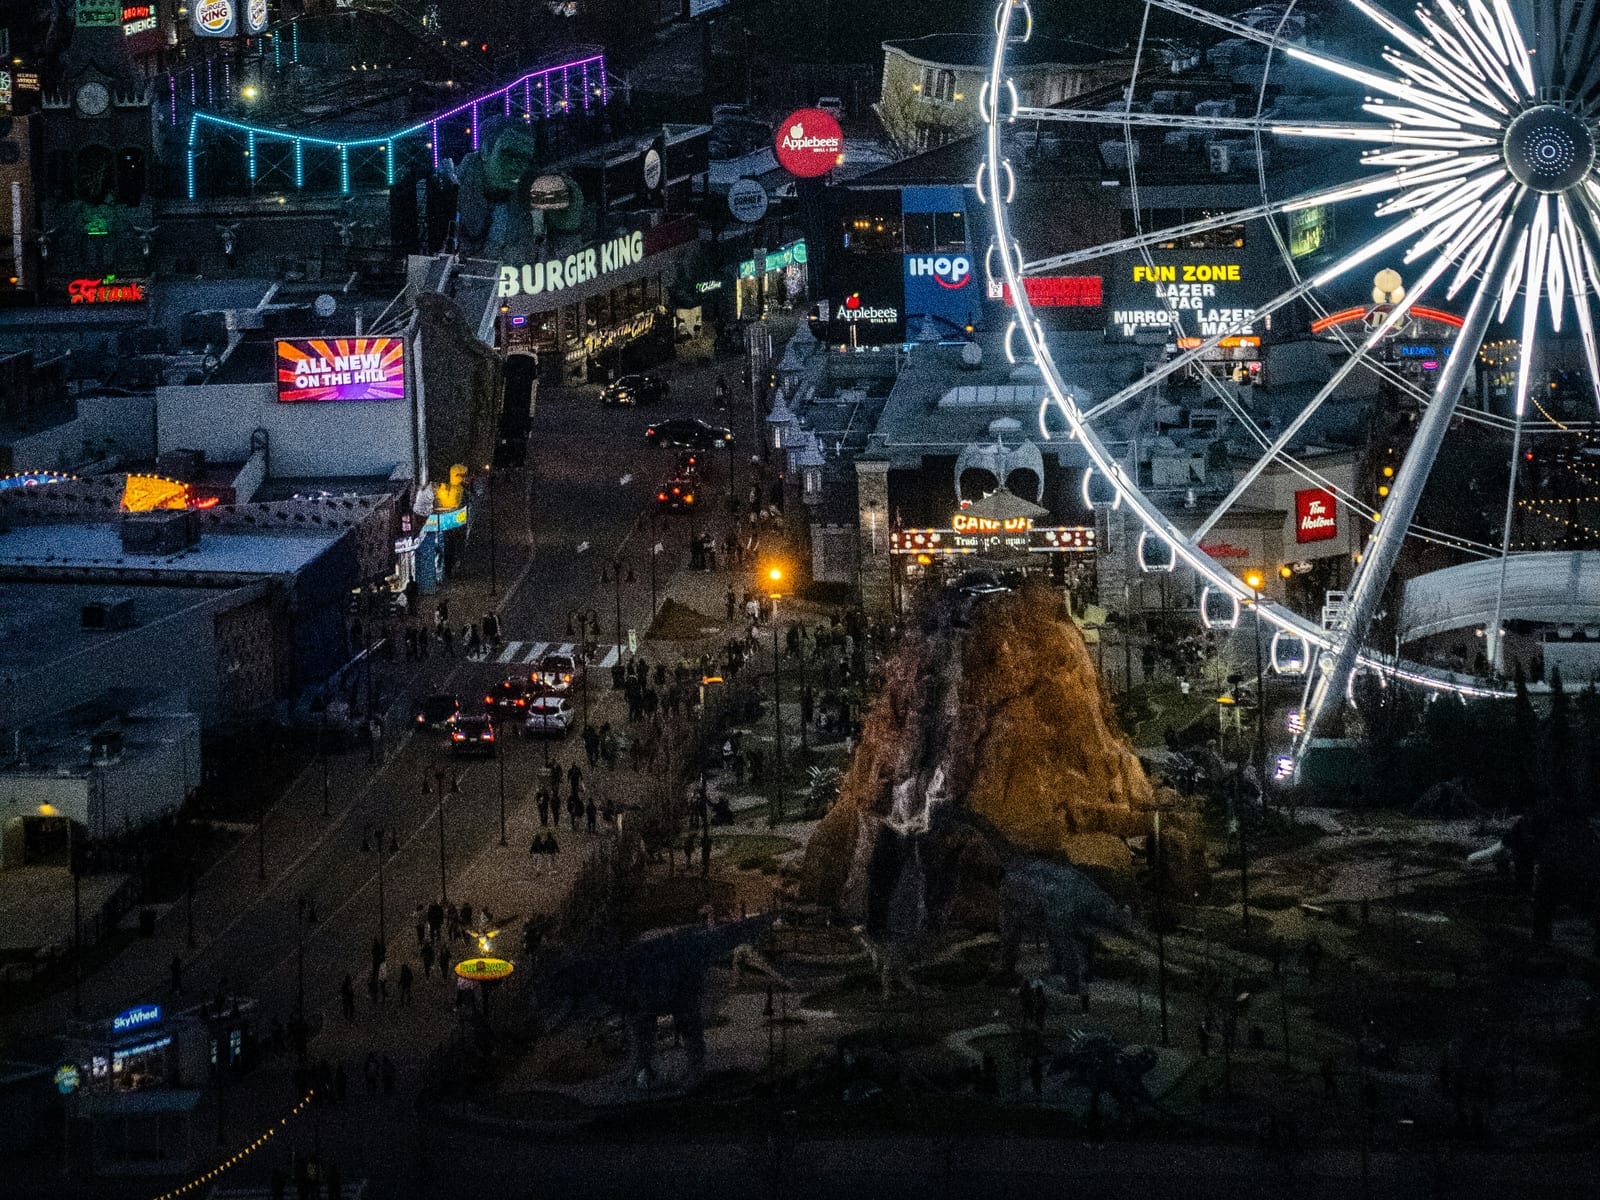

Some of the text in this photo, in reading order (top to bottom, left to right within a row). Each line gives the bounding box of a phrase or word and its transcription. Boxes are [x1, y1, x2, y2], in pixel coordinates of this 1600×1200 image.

[201, 8, 228, 24] KING
[781, 135, 839, 151] Applebee's
[498, 230, 644, 298] BURGER KING
[909, 257, 970, 282] IHOP
[1132, 265, 1241, 282] FUN ZONE
[1155, 284, 1215, 297] LAZER
[1170, 296, 1204, 310] TAG
[836, 304, 898, 322] Applebee's
[1114, 310, 1180, 324] MIRROR
[295, 351, 381, 375] ALL NEW
[295, 369, 388, 388] ON THE HILL
[1309, 500, 1326, 516] Tim
[1301, 515, 1336, 530] Hortons
[954, 536, 989, 552] Tradig
[113, 1007, 159, 1029] SkyWheel
